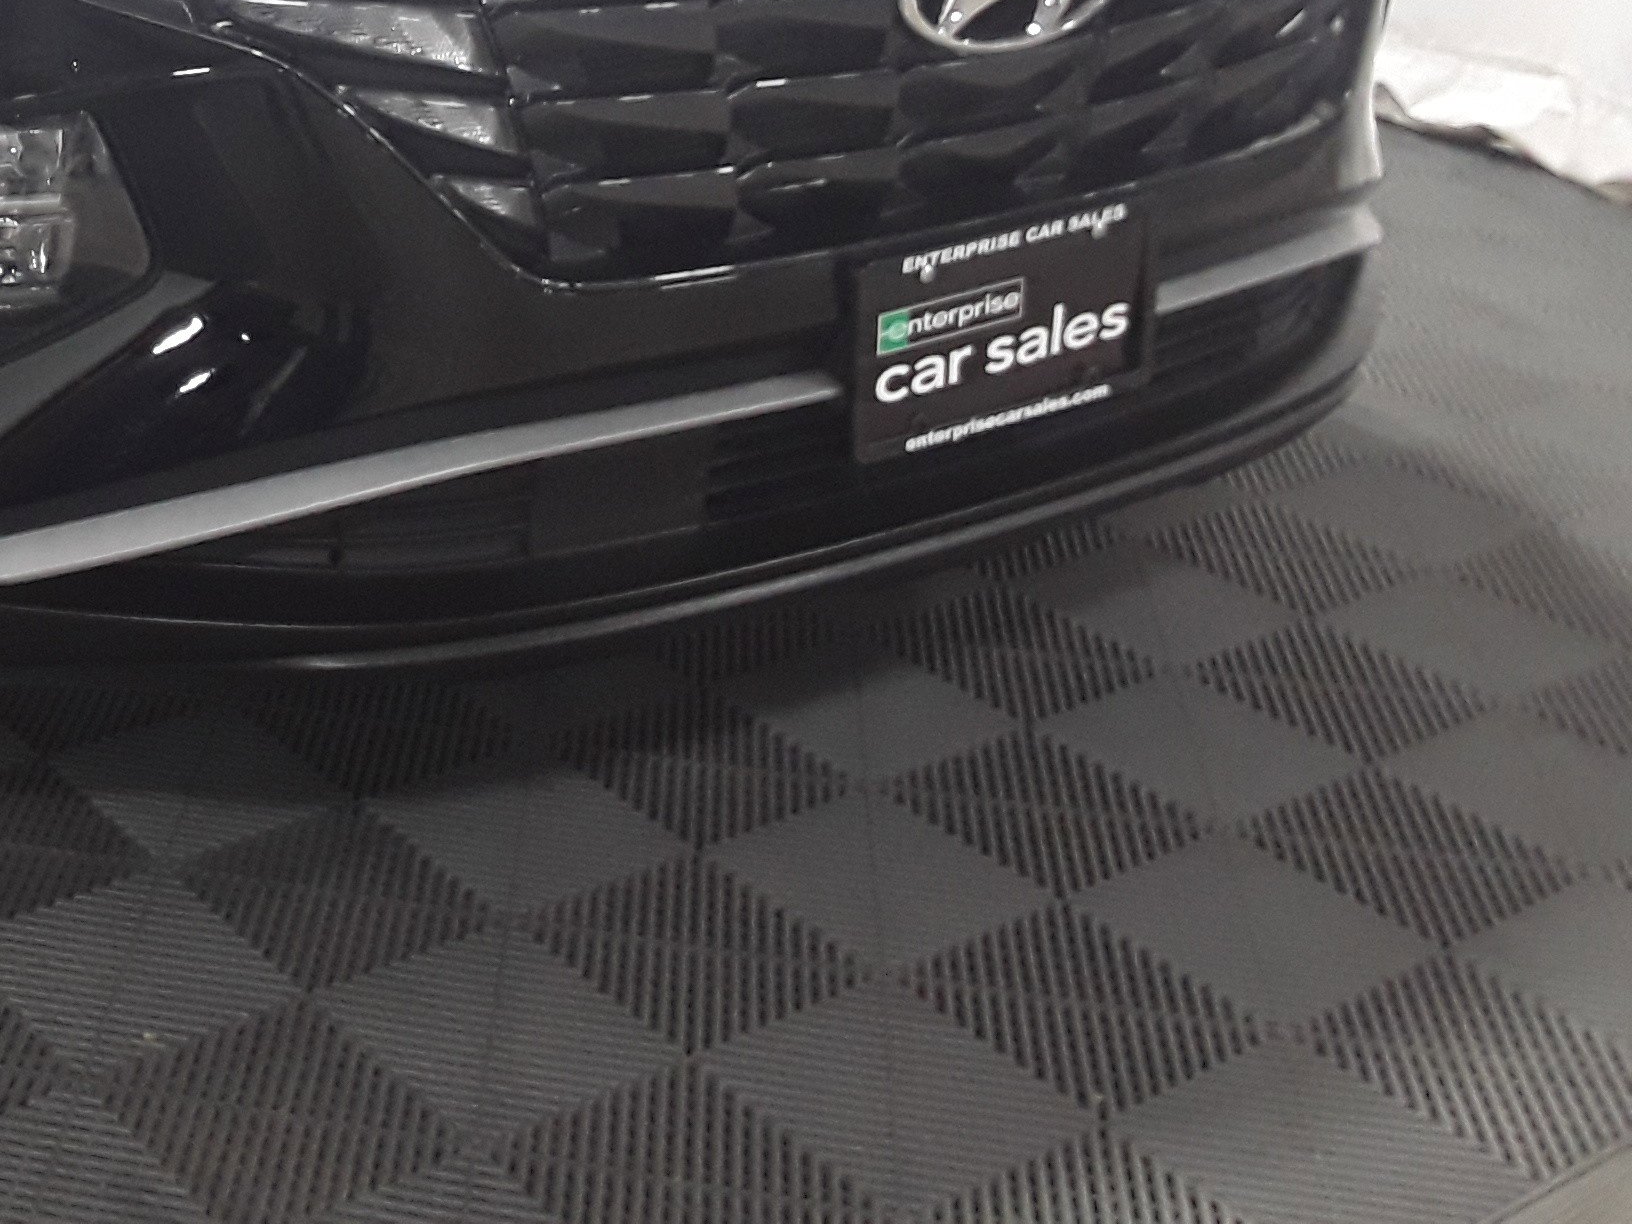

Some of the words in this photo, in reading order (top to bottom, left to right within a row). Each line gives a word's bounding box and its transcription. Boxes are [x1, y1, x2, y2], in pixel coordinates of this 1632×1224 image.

[902, 230, 1021, 274] ENTERPRISE
[1025, 219, 1065, 243] CAR
[1068, 203, 1128, 233] SALES
[885, 291, 1020, 341] enterprise
[875, 344, 973, 404] car
[984, 302, 1130, 374] sales
[905, 383, 1112, 453] enterprisecarsales.com
